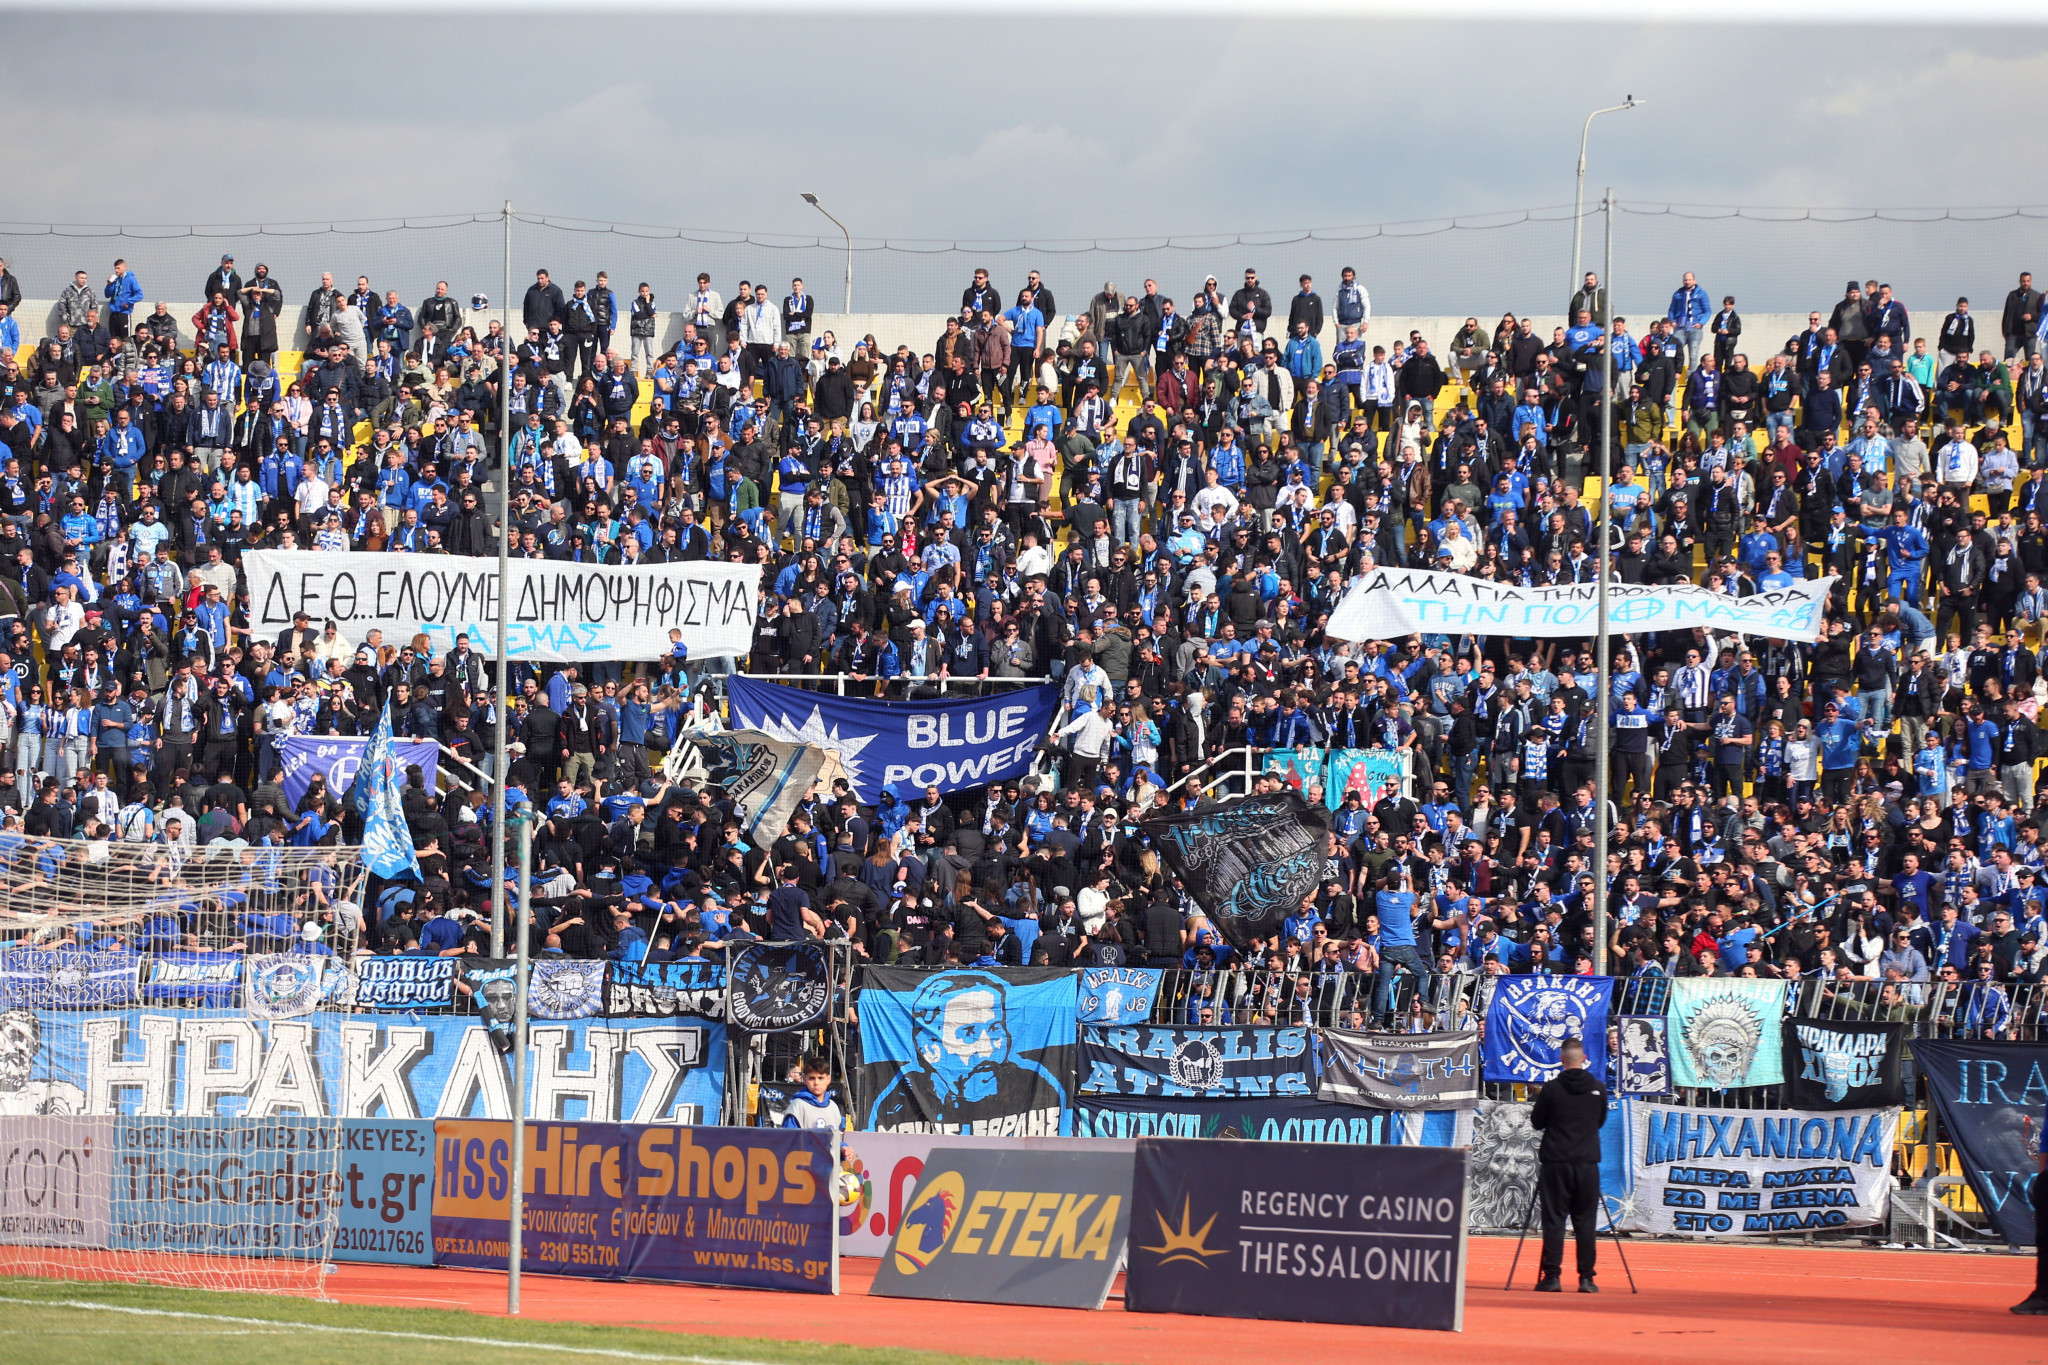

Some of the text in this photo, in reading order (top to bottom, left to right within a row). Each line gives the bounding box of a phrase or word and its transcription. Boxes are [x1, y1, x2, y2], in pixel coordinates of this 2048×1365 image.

[516, 573, 752, 627] ΔΗΜΟΨΗΦΙΣΜΑ
[1365, 572, 1461, 597] ΑΛΛΑ
[1472, 583, 1524, 601] ΓΙΑ
[1533, 586, 1596, 602] ΤΗΝ
[1403, 597, 1509, 625] ΤΗΝ
[907, 705, 1028, 749] BLUE
[884, 733, 1039, 789] POWER
[732, 991, 751, 1019] GOOD
[773, 1009, 809, 1027] WHITE
[805, 982, 826, 1015] PRIDE
[1081, 996, 1099, 1012] 19
[1372, 1039, 1428, 1049] ΗΡΑΚΛΗΣ
[1796, 1024, 1888, 1057] ΗΡΑΚΛΑΡΑ
[80, 1013, 703, 1124] ΗΡΑΚΛΗΣ
[1953, 1059, 2048, 1107] IRA
[1396, 1093, 1439, 1102] ΛΑΤΡΕΙΑ
[125, 1127, 162, 1148] ΘΕΣ
[306, 1128, 426, 1158] ΣΥΣΚΕΥΕΣ;
[1645, 1110, 1884, 1168] ΜΗΧΑΝΙΩΝΑ
[441, 1136, 510, 1202] HSS
[523, 1124, 621, 1199] Hire
[637, 1127, 816, 1215] Shops
[1668, 1166, 1856, 1188] ΜΕΡΑ ΝΥΧΤΑ
[124, 1153, 426, 1223] ThesGadget.gr
[1663, 1187, 1859, 1210] ΖΩ ΜΕ ΕΣΕΝΑ
[1240, 1189, 1455, 1224] REGENCY CASINO
[1673, 1210, 1849, 1232] ΣΤΟ ΜΥΑΛΟ
[521, 1201, 810, 1248] Ενοικιάσεις Εγαλείων & Μηχανημάτων
[332, 1228, 425, 1255] 2310217626
[540, 1240, 569, 1263] 2310
[693, 1250, 829, 1280] www.hss.gr
[1239, 1240, 1452, 1284] THESSALONIKI
